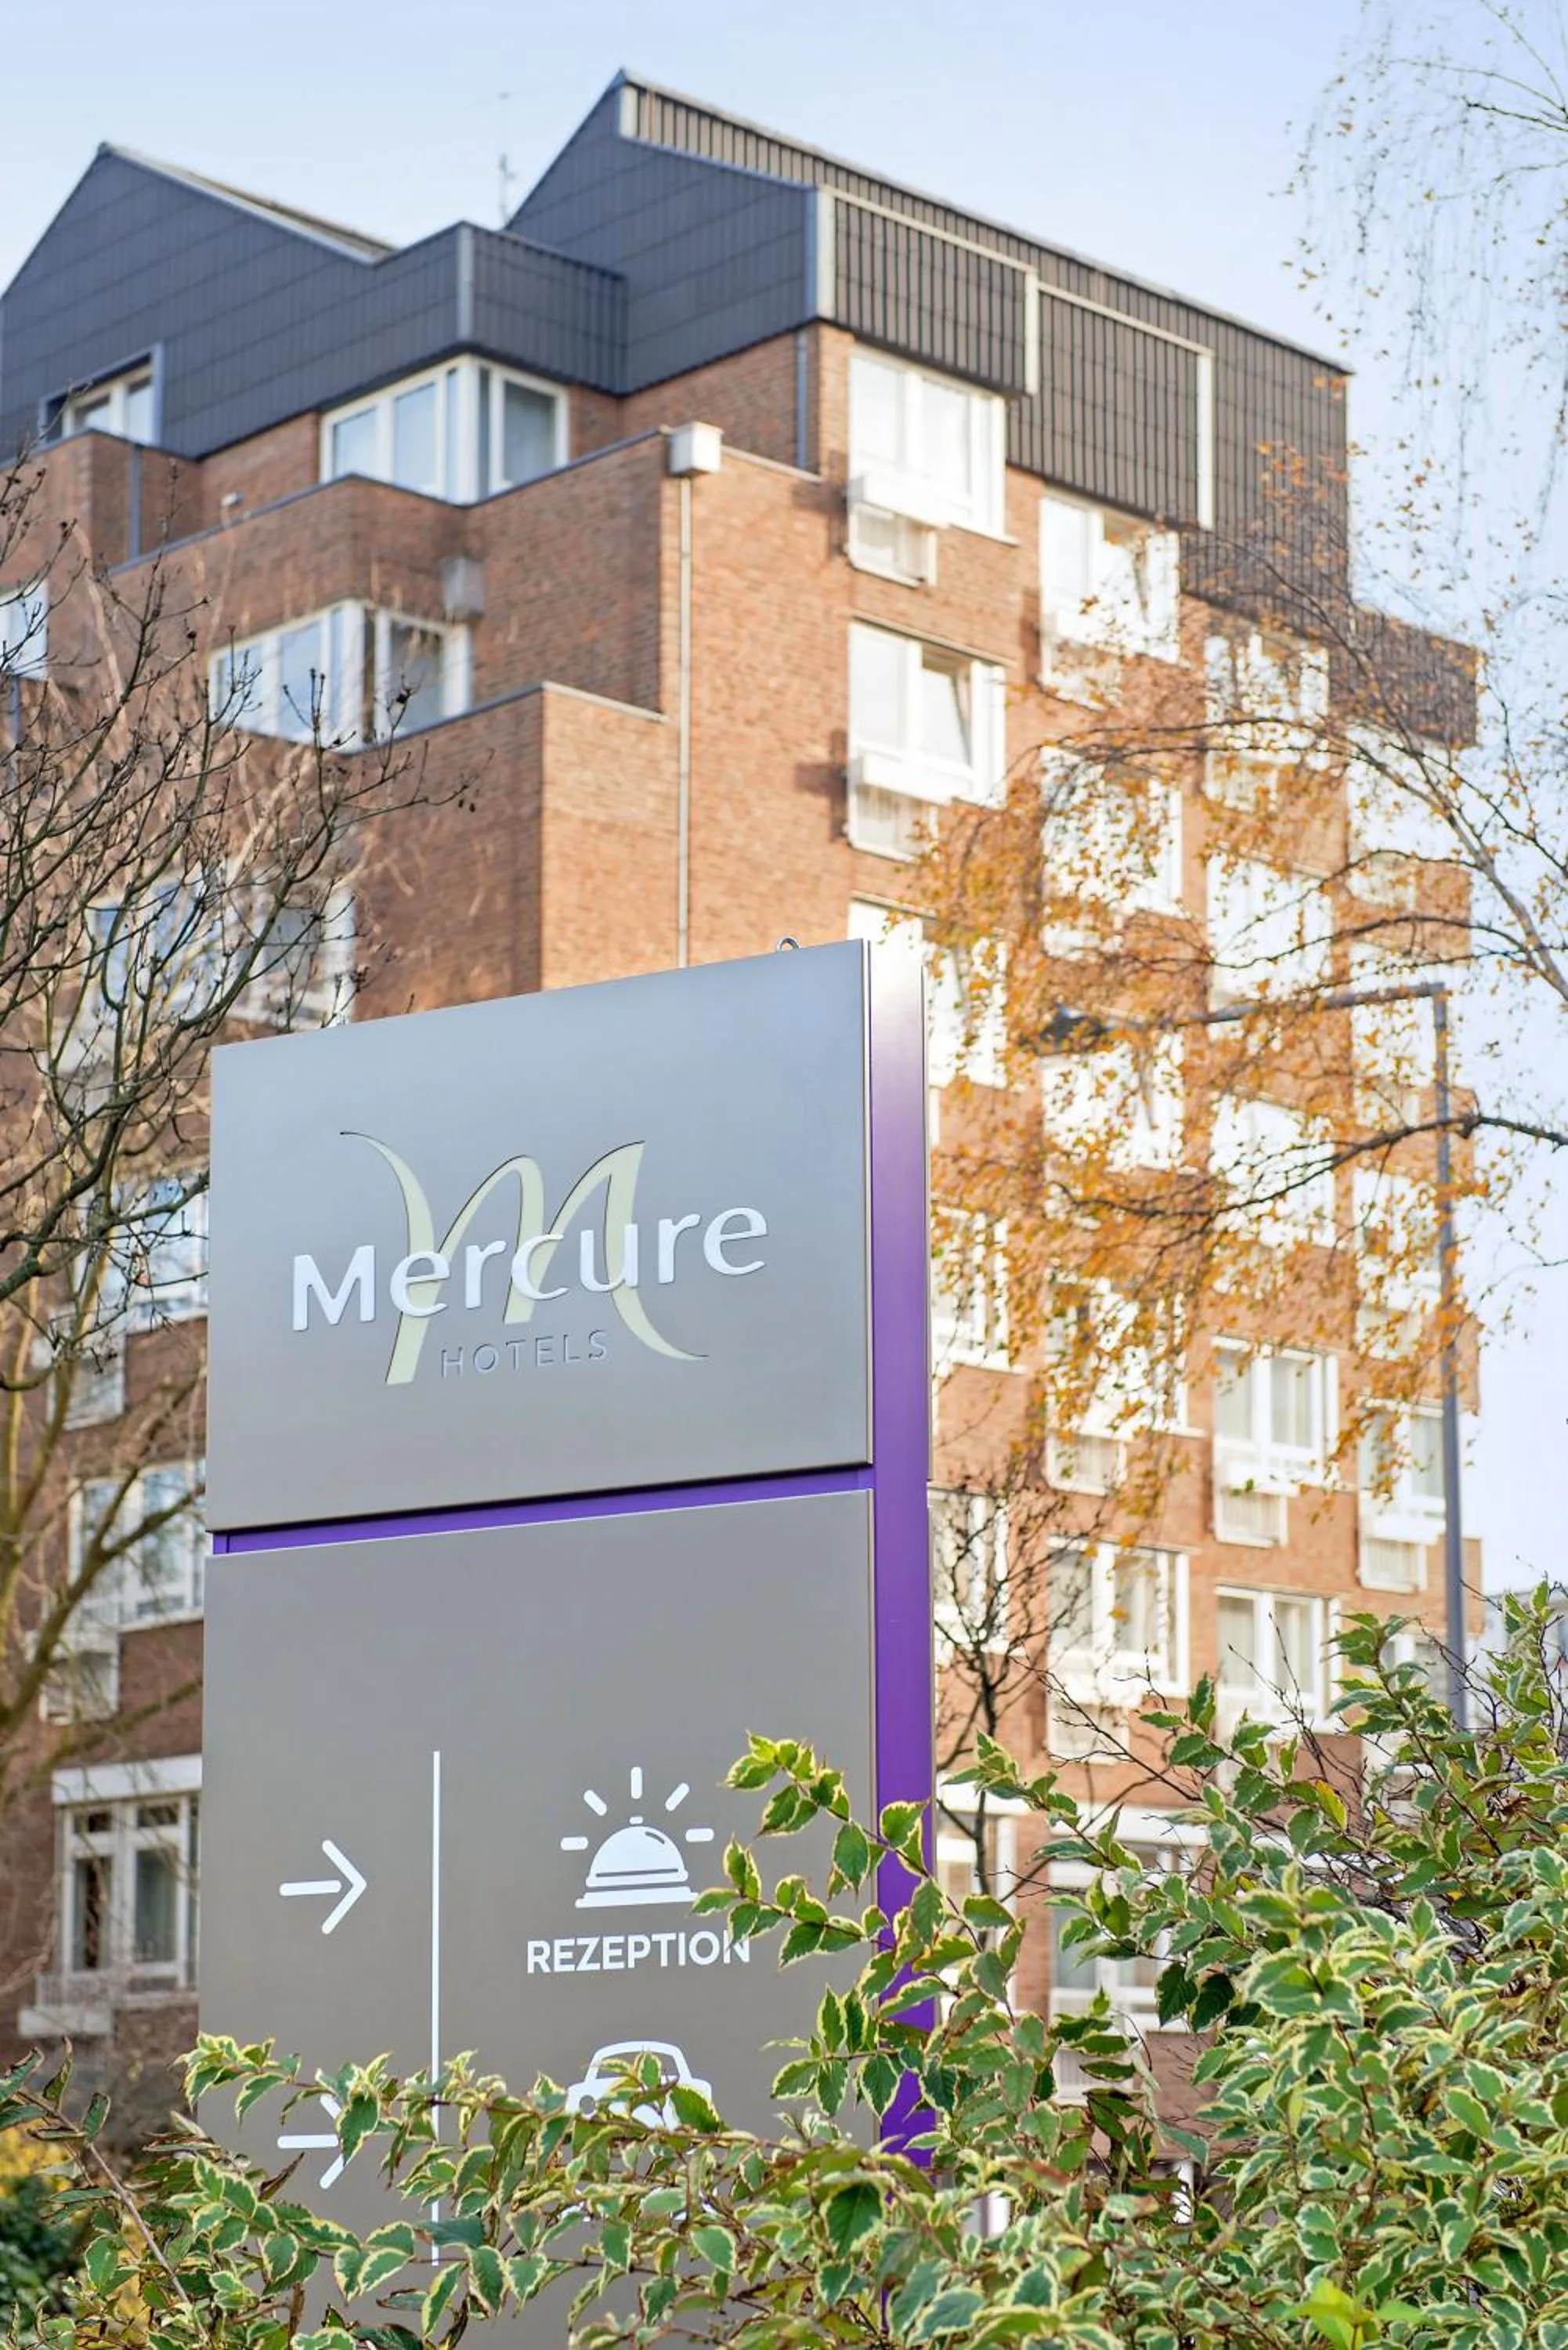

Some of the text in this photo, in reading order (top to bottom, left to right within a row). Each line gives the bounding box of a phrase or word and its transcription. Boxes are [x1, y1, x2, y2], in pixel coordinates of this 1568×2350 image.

[292, 1206, 768, 1331] Mercure
[439, 1329, 608, 1379] HOTELS
[526, 1929, 751, 1974] REZEPTION
